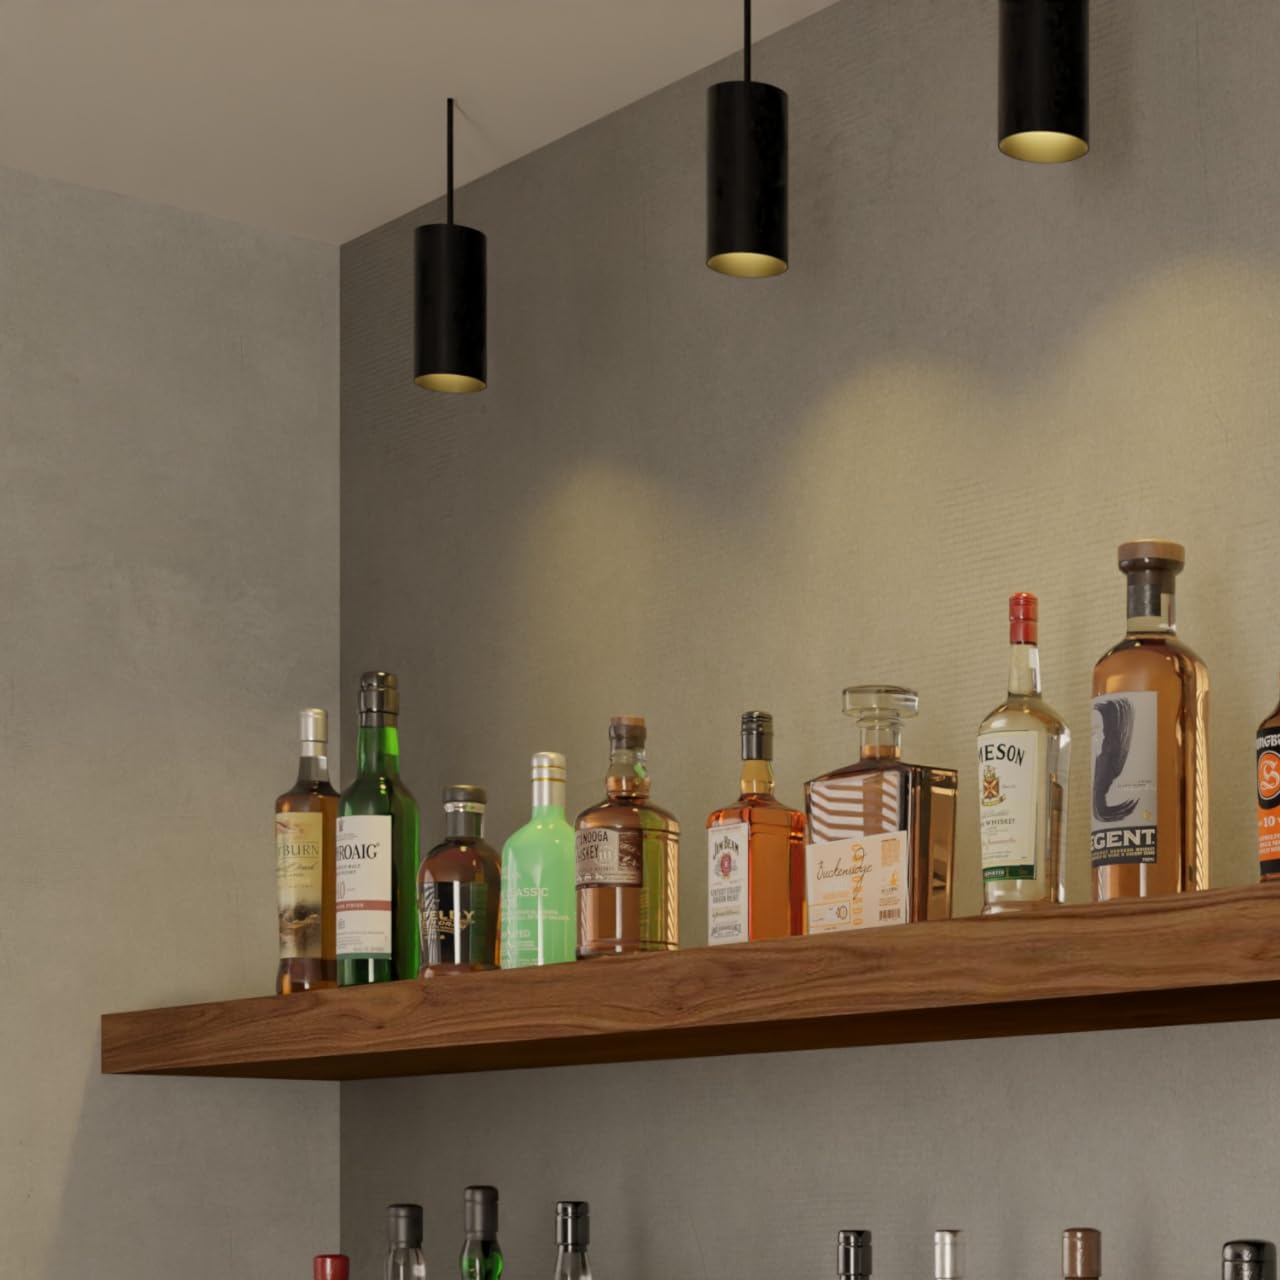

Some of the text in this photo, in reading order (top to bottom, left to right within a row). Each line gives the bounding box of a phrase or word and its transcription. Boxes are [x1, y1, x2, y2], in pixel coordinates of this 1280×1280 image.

[1263, 815, 1276, 828] 10
[278, 844, 320, 857] BURN
[510, 887, 550, 897] ASSIC
